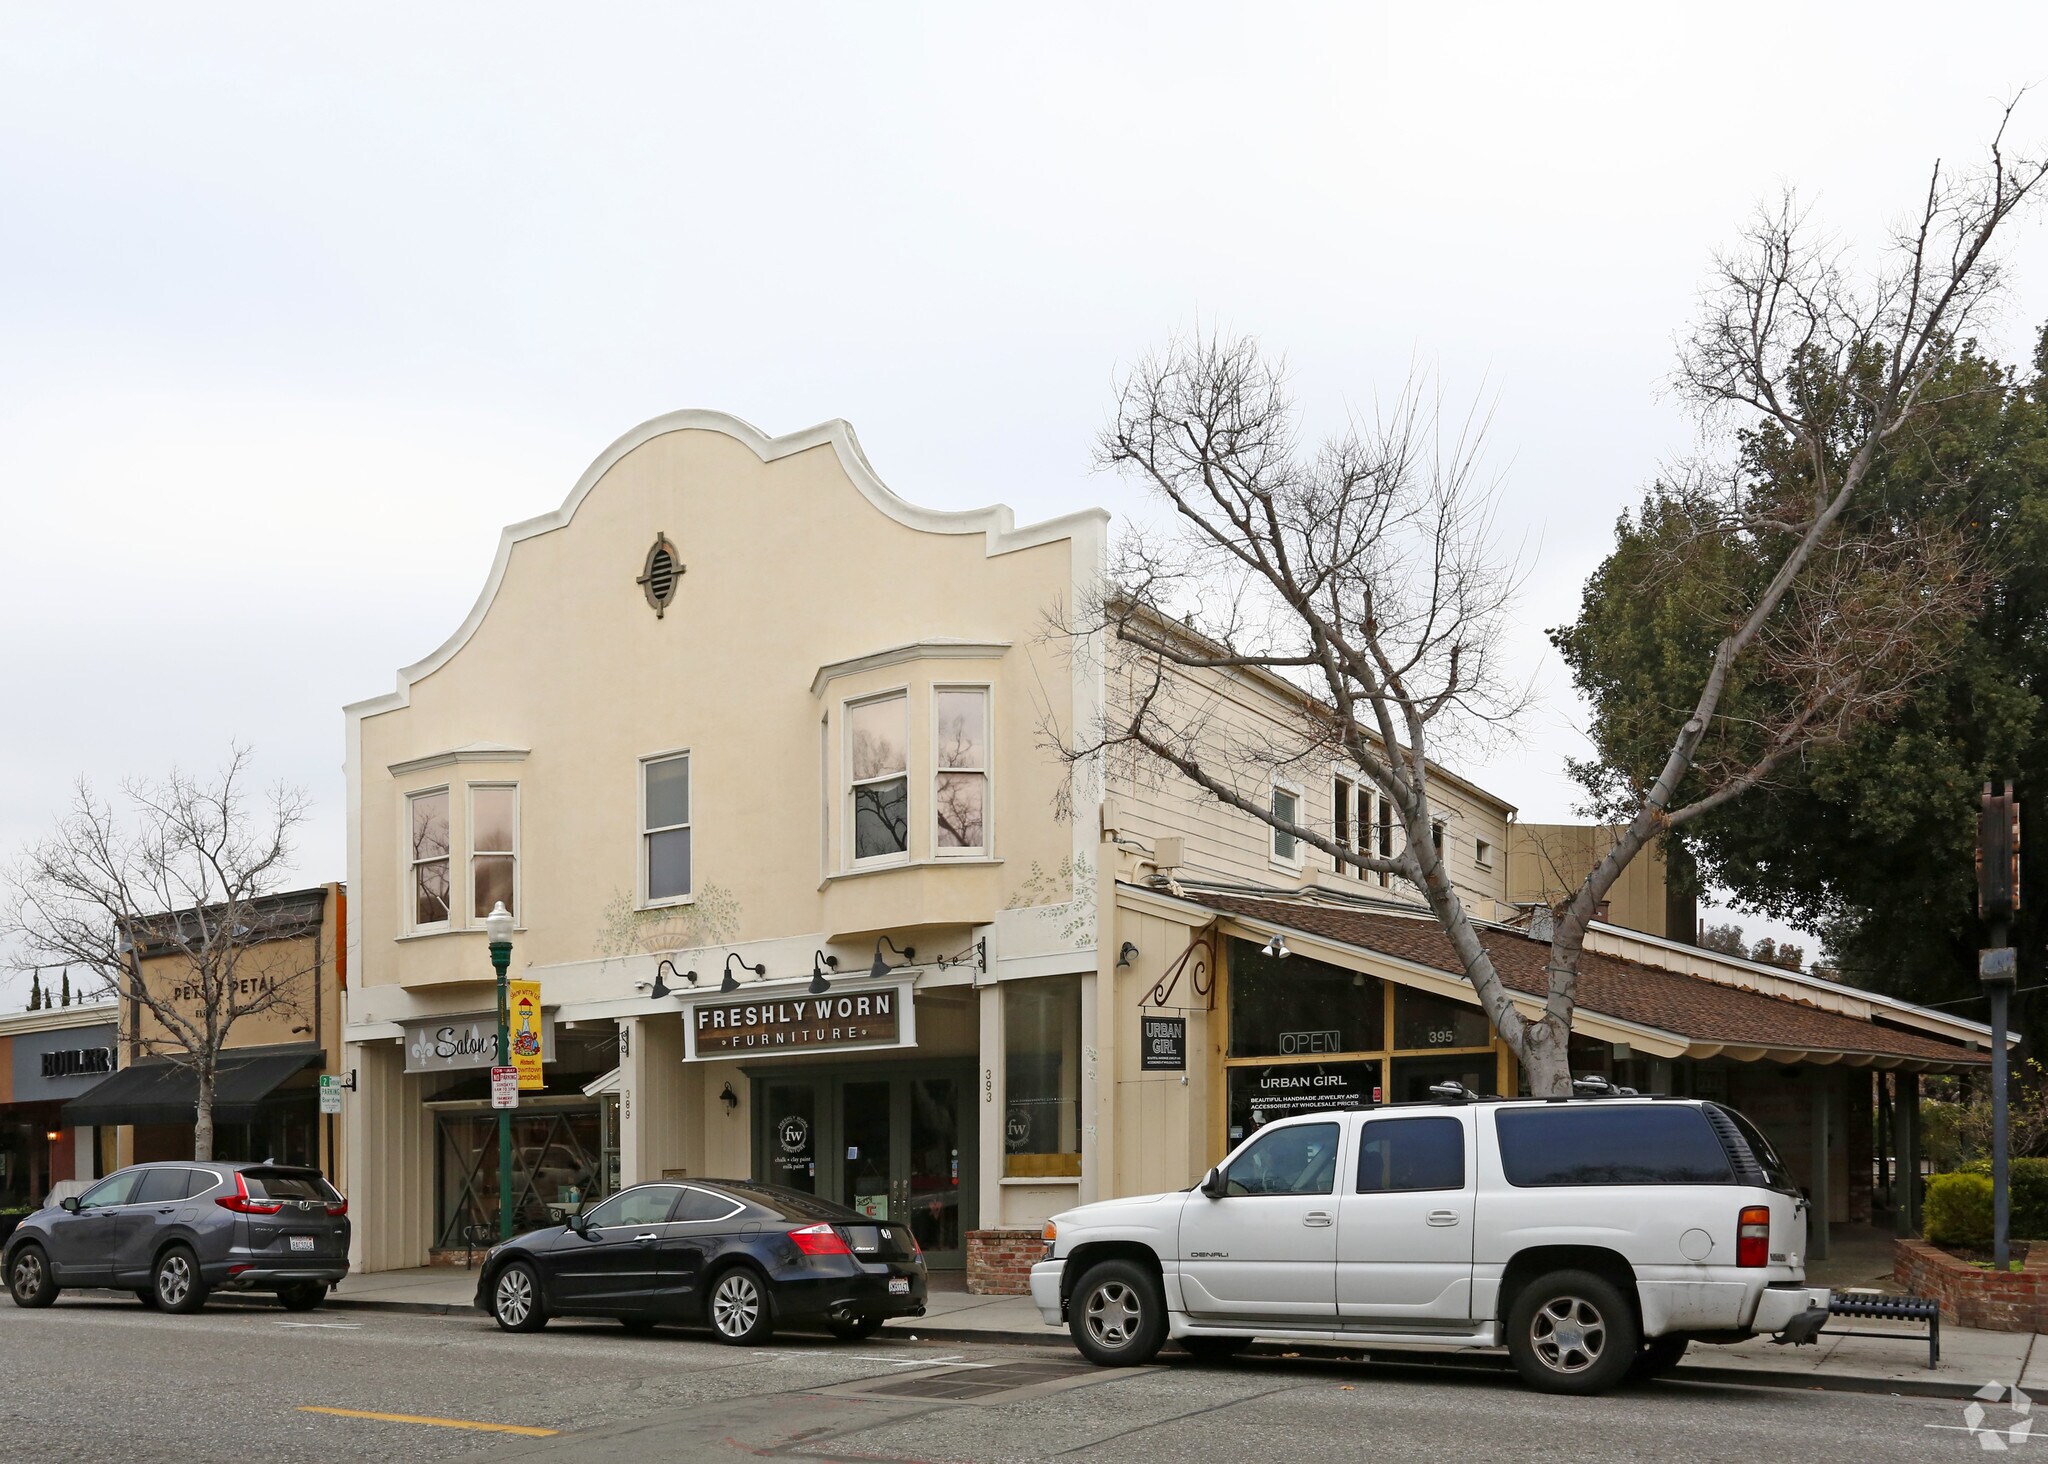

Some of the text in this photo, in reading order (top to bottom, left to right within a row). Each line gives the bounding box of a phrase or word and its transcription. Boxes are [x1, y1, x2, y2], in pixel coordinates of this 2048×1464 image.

[698, 995, 890, 1029] FRESHLY WORN
[732, 1026, 858, 1047] FURNITURE
[1146, 1022, 1182, 1038] URBAN
[1429, 1030, 1453, 1043] 395
[435, 1026, 488, 1058] Salon
[1152, 1038, 1177, 1054] GIRL
[1282, 1033, 1338, 1053] OPEN
[1261, 1075, 1348, 1089] URBAN GIRL
[321, 1088, 340, 1096] PARKING
[785, 1126, 803, 1141] fw
[1008, 1119, 1027, 1135] fw
